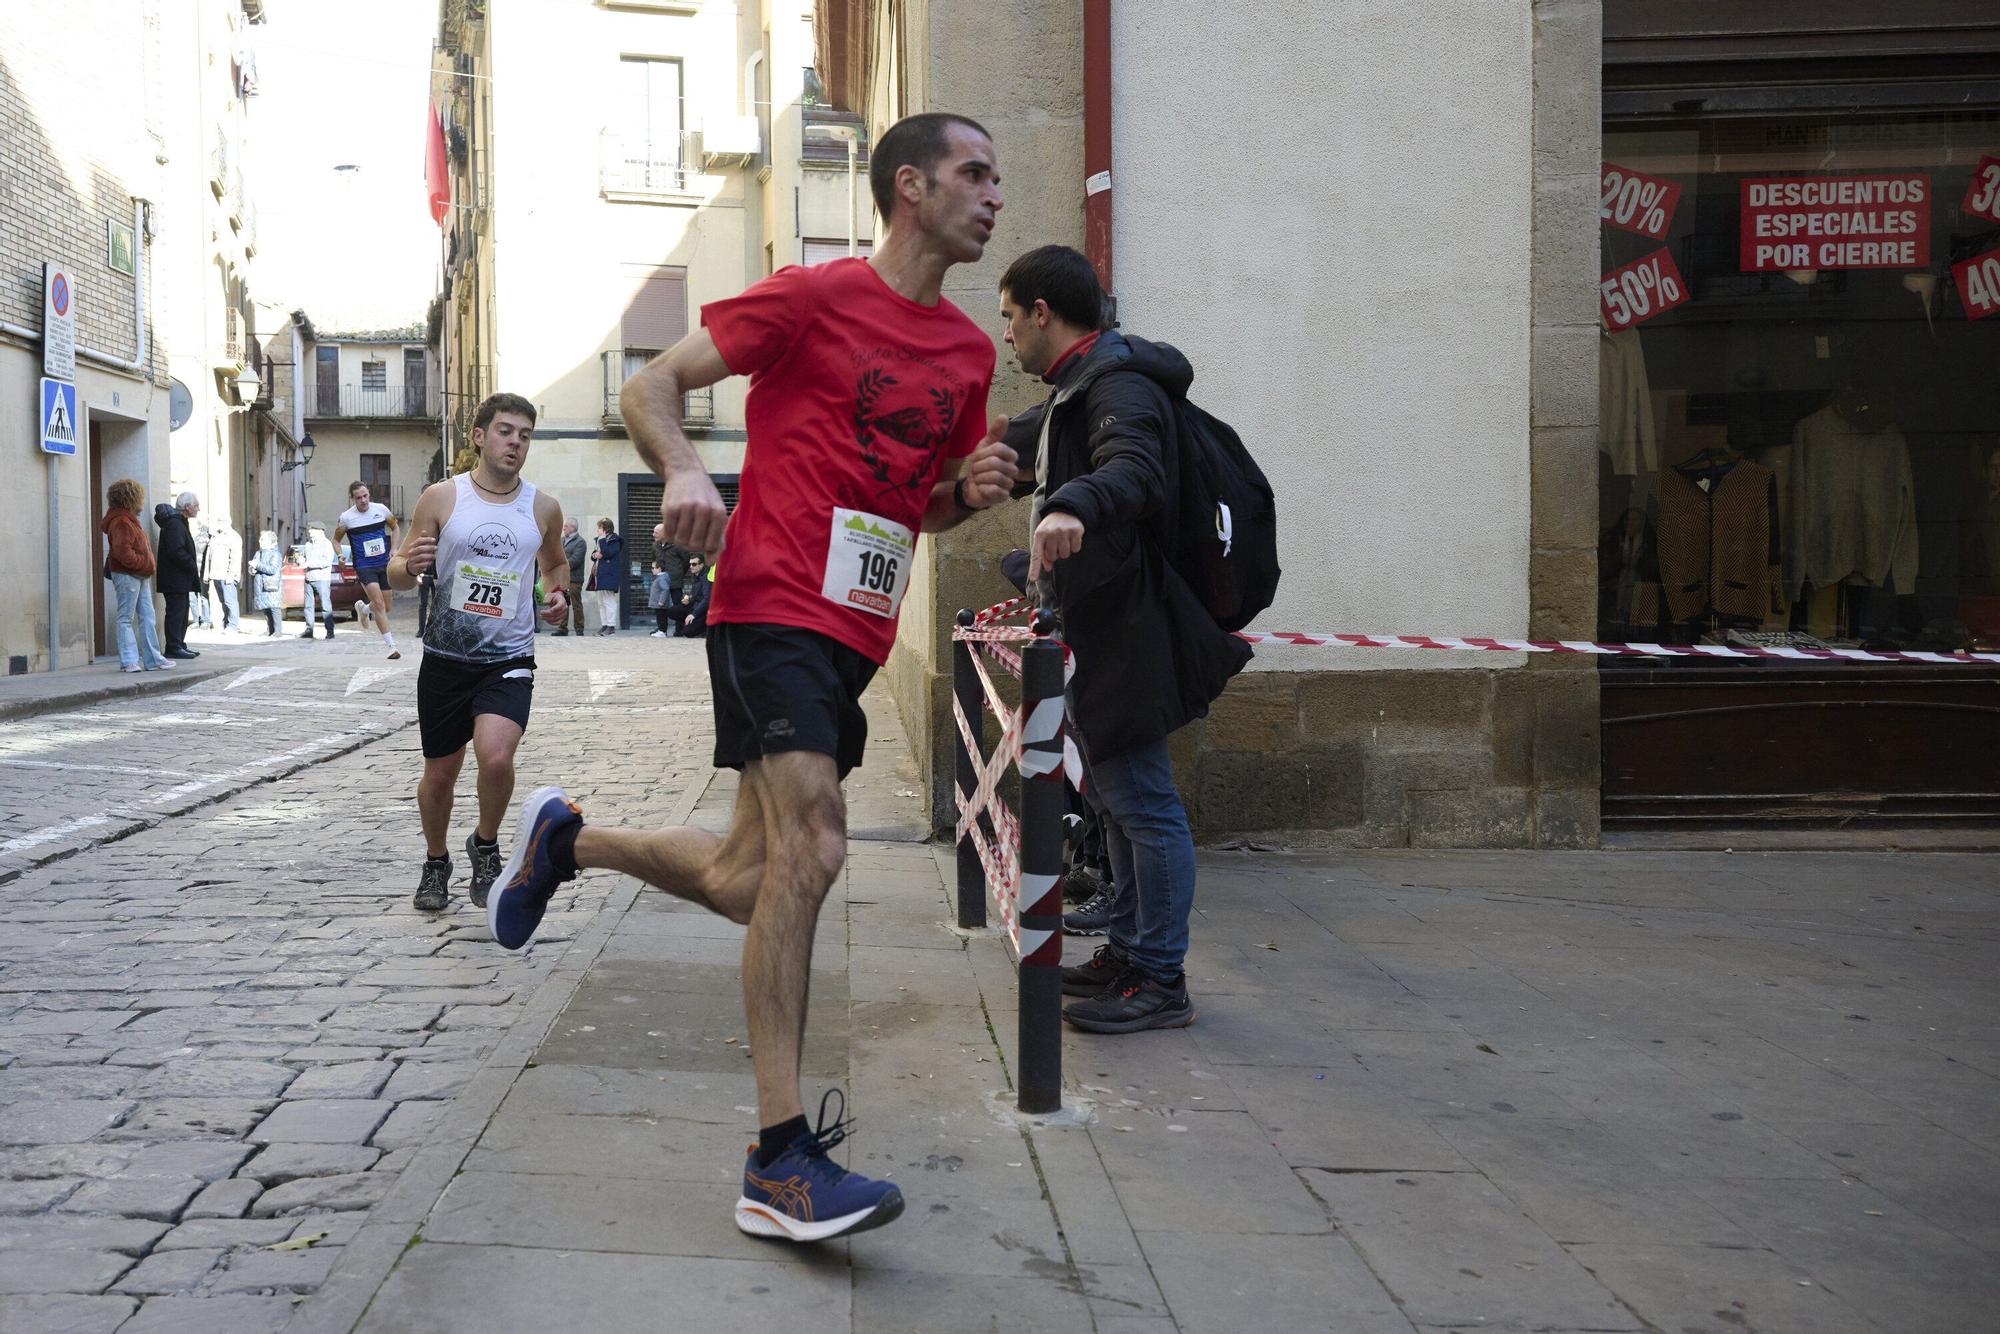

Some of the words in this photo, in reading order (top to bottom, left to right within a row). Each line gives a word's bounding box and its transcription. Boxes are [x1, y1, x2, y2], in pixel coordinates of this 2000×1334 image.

[1601, 171, 1669, 234] 20%
[1749, 179, 1924, 207] DESCUENTOS
[1756, 210, 1917, 237] ESPECIALES
[1756, 244, 1810, 268] POR
[1819, 241, 1916, 266] CIERRE
[1601, 257, 1680, 325] 50%
[859, 550, 898, 594] 196
[467, 583, 502, 606] 273
[464, 603, 502, 616] navarban
